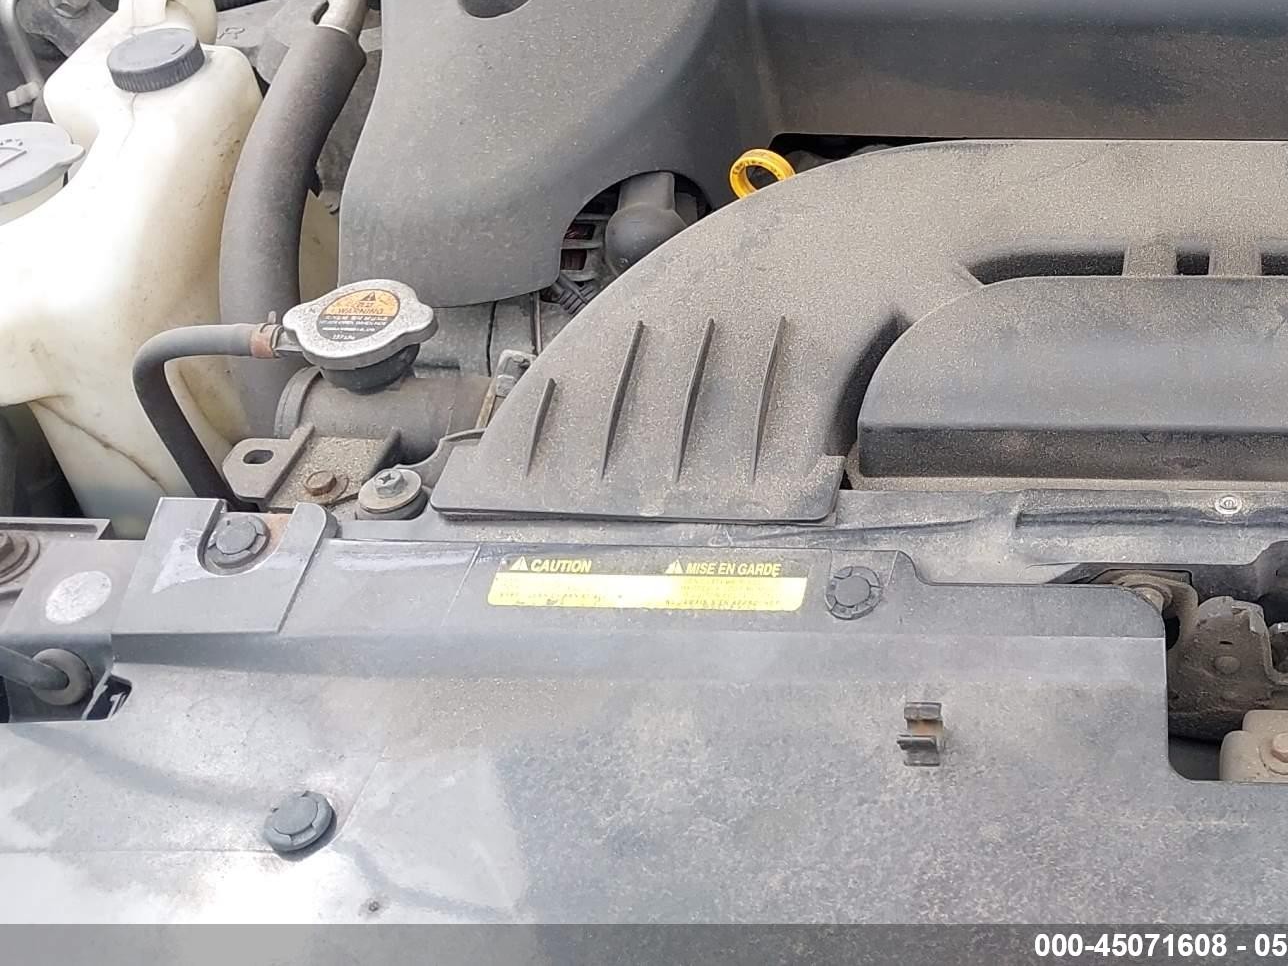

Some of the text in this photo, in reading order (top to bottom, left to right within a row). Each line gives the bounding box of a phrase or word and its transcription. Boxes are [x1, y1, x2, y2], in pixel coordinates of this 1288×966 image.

[530, 559, 592, 573] CAUTION
[686, 562, 782, 577] MISE EN GARDE
